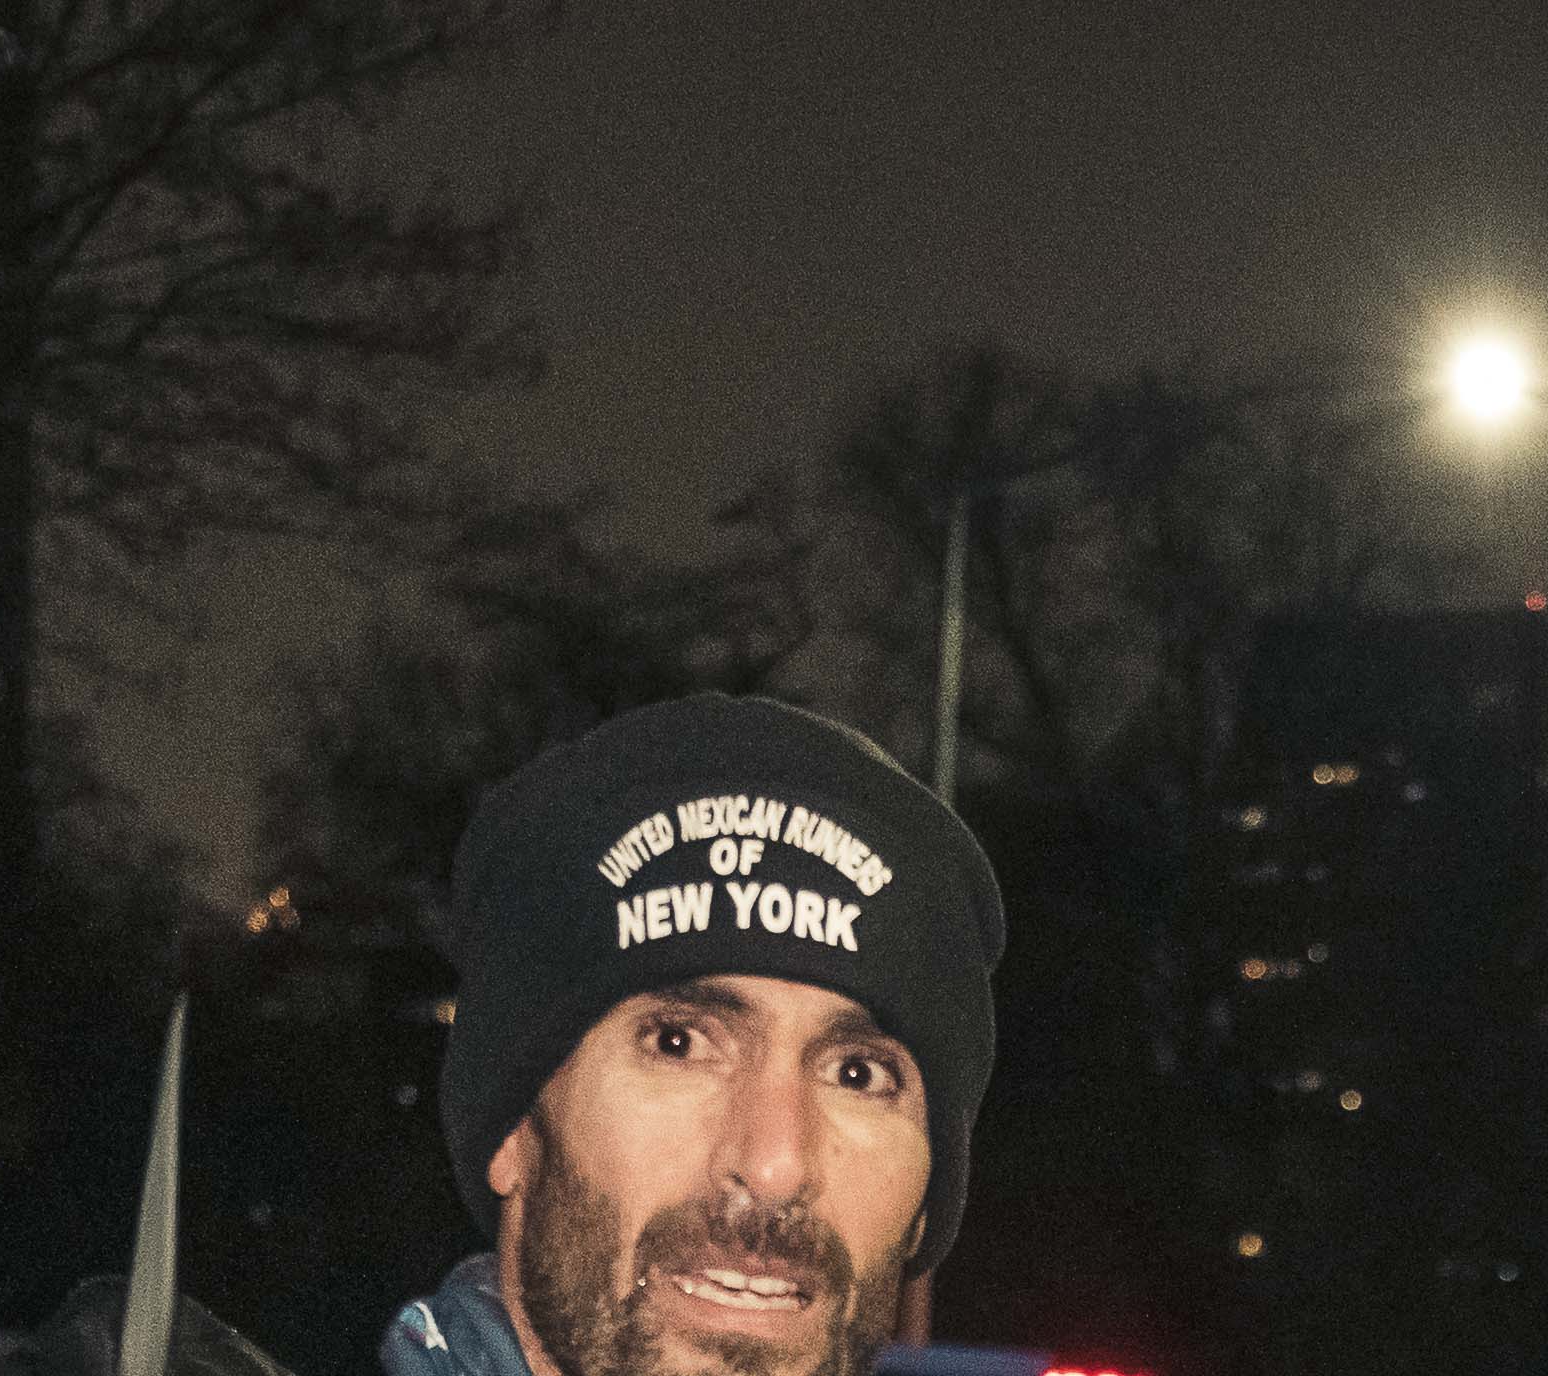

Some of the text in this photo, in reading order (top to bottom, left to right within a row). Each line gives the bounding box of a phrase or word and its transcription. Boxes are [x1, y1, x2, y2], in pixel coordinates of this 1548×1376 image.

[598, 794, 892, 896] UNITED MEXICAN RUNNERS
[709, 838, 764, 876] OF
[617, 882, 861, 952] NEW YORK
